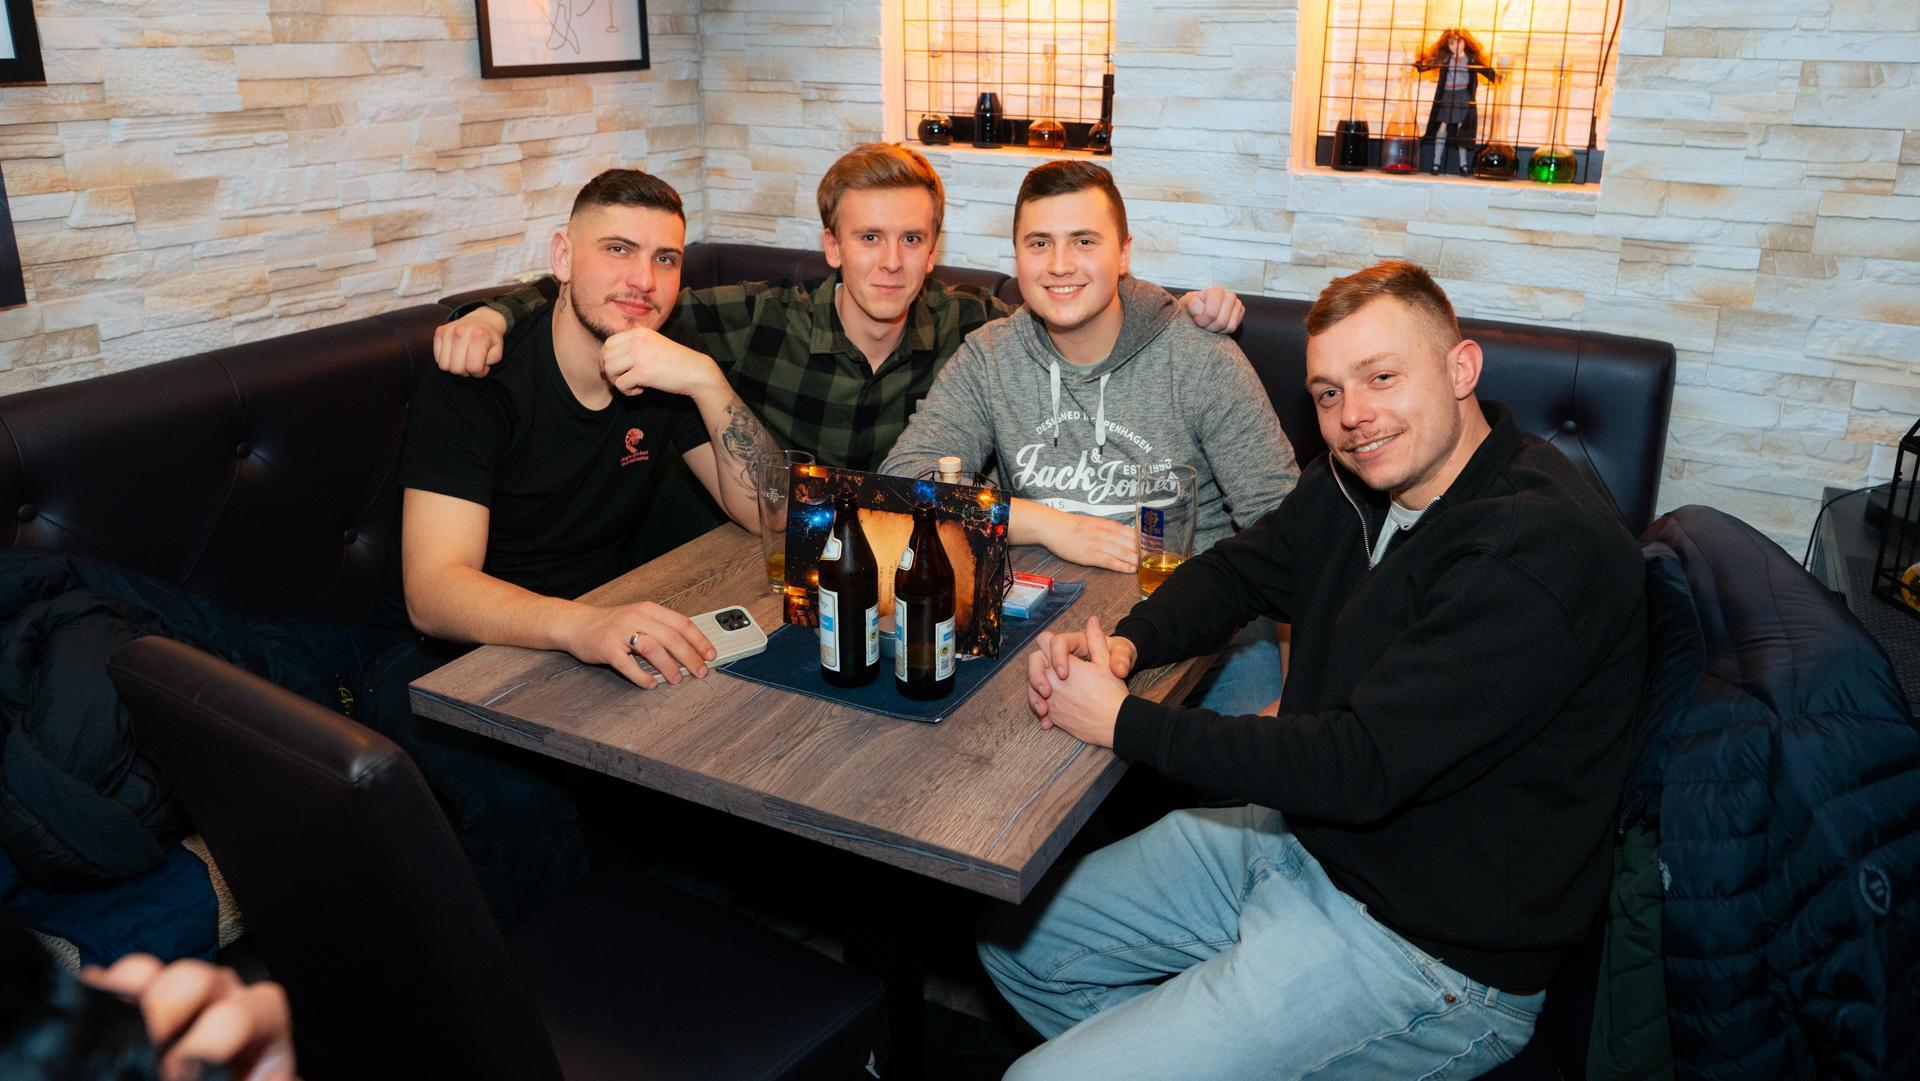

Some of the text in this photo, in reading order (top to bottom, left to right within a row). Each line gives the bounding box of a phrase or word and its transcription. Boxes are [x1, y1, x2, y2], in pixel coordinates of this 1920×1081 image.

[1035, 411, 1081, 435] DESIGNED
[1090, 417, 1153, 454] PENHAGEN
[1012, 443, 1179, 504] Jack & Jones
